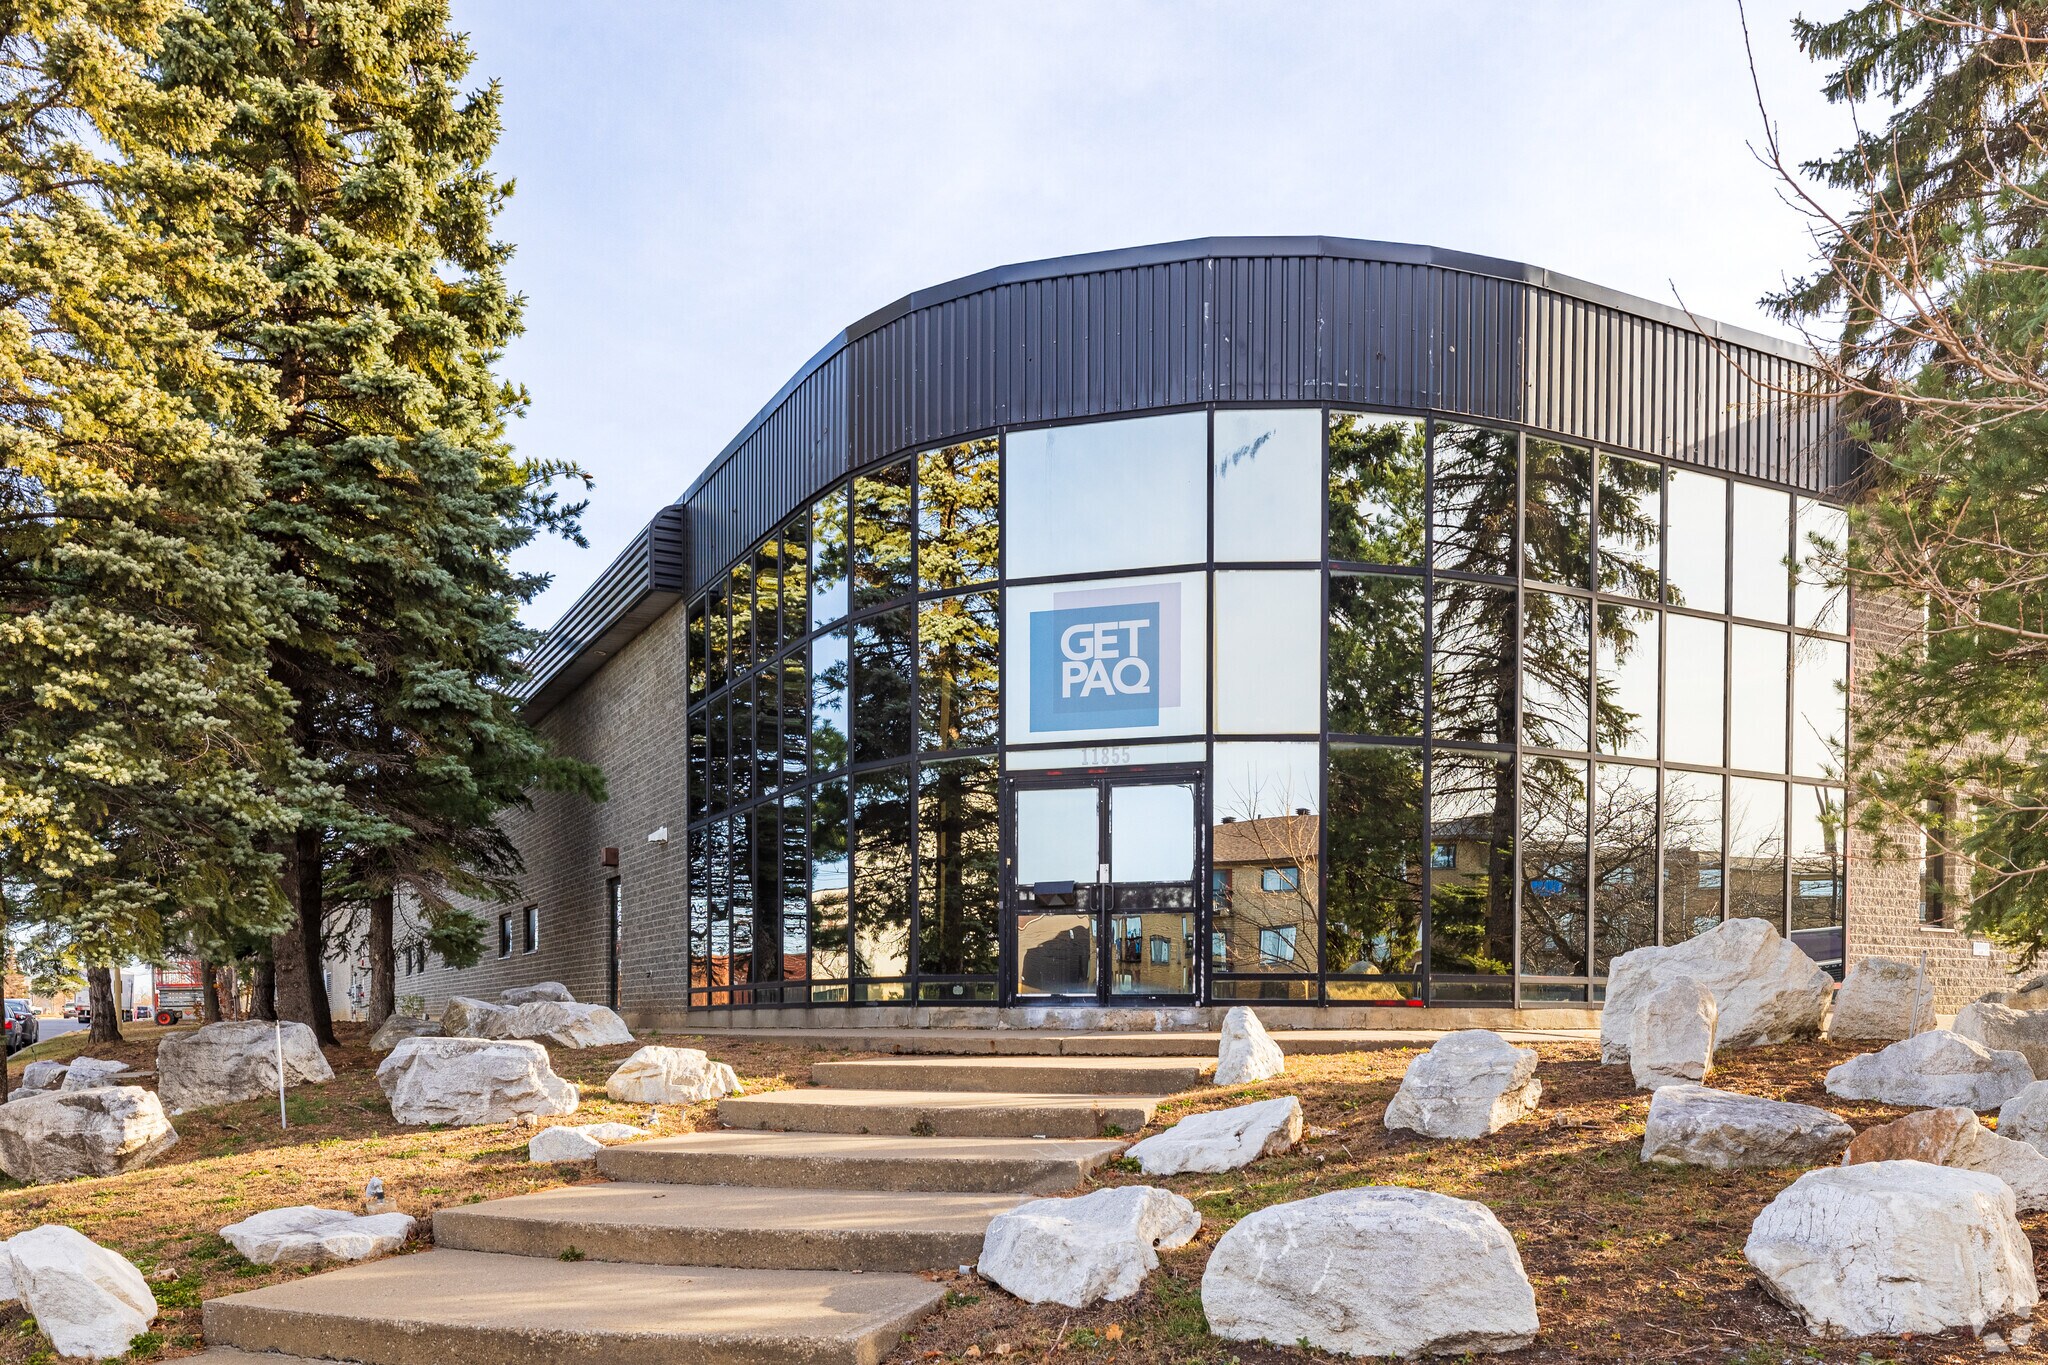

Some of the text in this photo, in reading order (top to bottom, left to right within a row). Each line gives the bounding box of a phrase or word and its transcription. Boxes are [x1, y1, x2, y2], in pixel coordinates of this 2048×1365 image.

[1060, 619, 1150, 661] GET
[1062, 657, 1150, 698] PAQ
[1081, 746, 1130, 765] 11855
